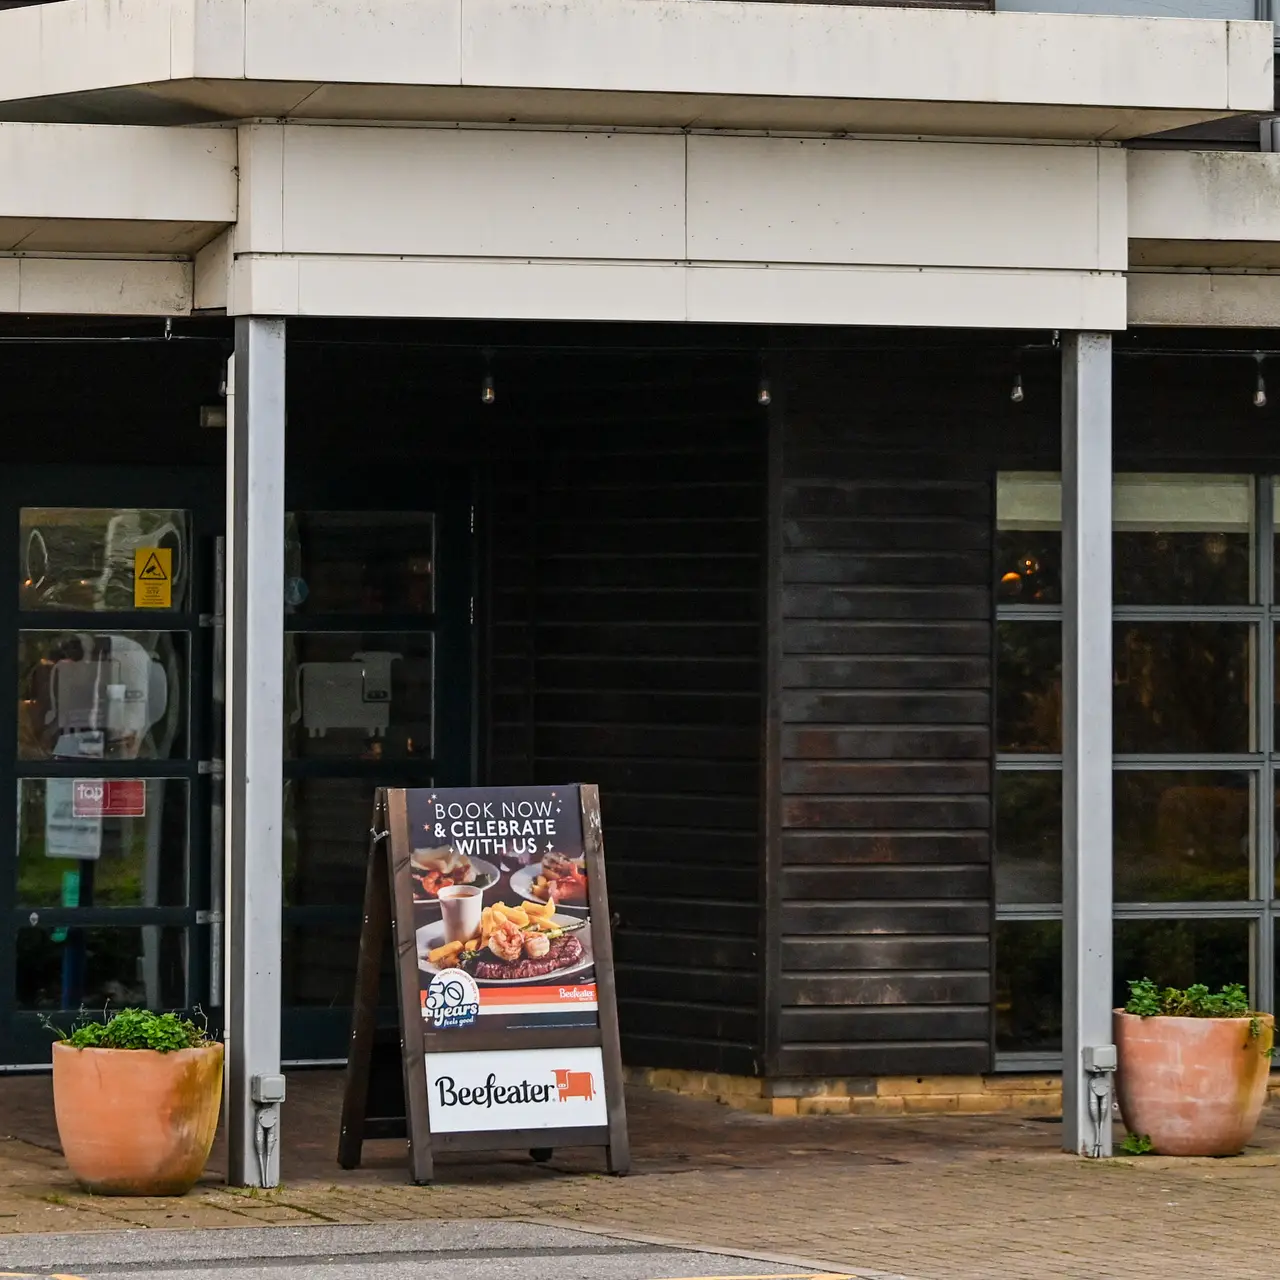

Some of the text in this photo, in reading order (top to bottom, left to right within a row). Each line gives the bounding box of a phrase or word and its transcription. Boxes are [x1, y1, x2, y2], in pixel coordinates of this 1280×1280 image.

[435, 801, 553, 819] BOOK NOW
[434, 819, 556, 838] & CELEBRATE
[455, 837, 538, 855] WITH US
[425, 981, 465, 1009] 50
[559, 987, 594, 999] Beefeater
[433, 1002, 479, 1026] years
[444, 1015, 474, 1027] feels good
[435, 1073, 555, 1108] Beefeater
